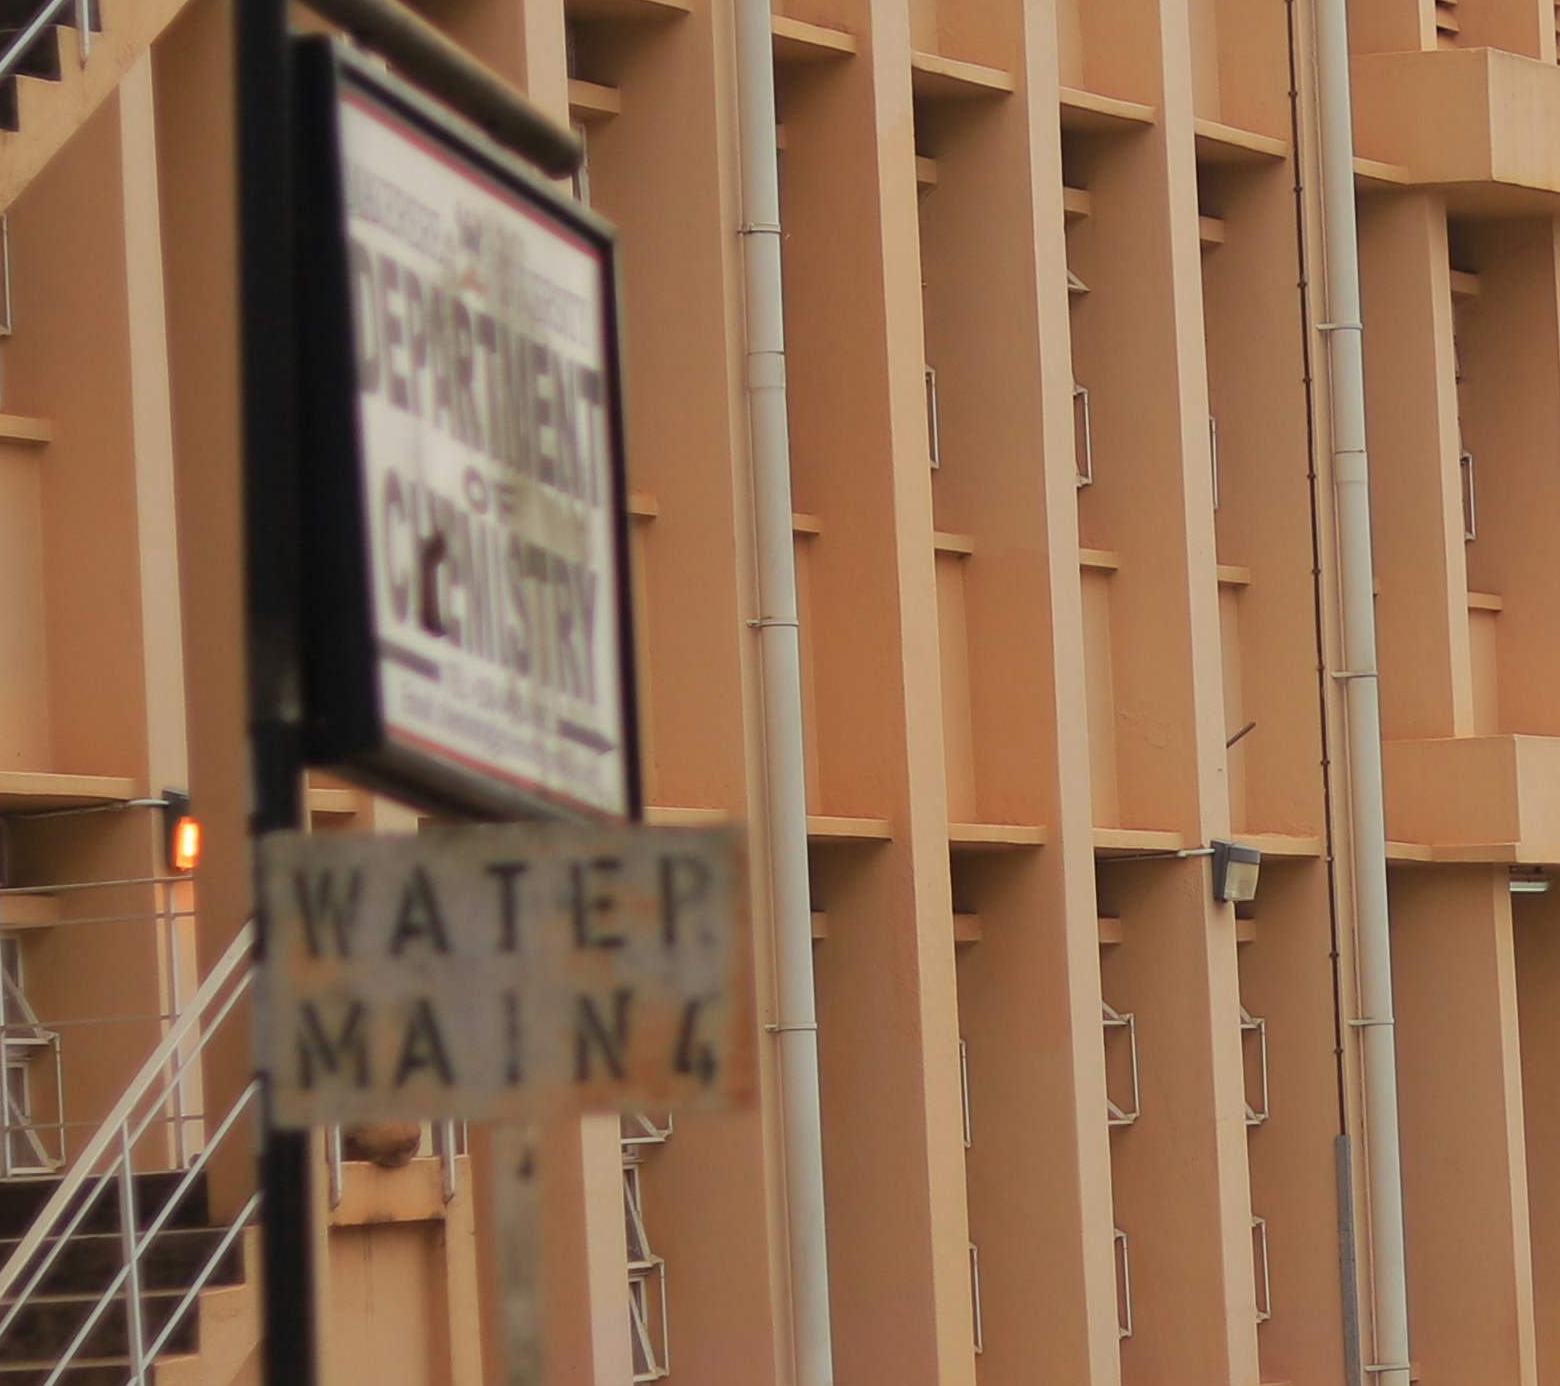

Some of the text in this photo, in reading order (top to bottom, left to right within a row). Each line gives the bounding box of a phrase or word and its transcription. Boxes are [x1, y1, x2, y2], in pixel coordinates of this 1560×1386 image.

[348, 240, 602, 507] DEPARTMENT
[460, 464, 518, 517] OF
[385, 469, 596, 704] CHEMISTRY
[293, 856, 716, 960] WATER
[296, 987, 637, 1093] MAIN
